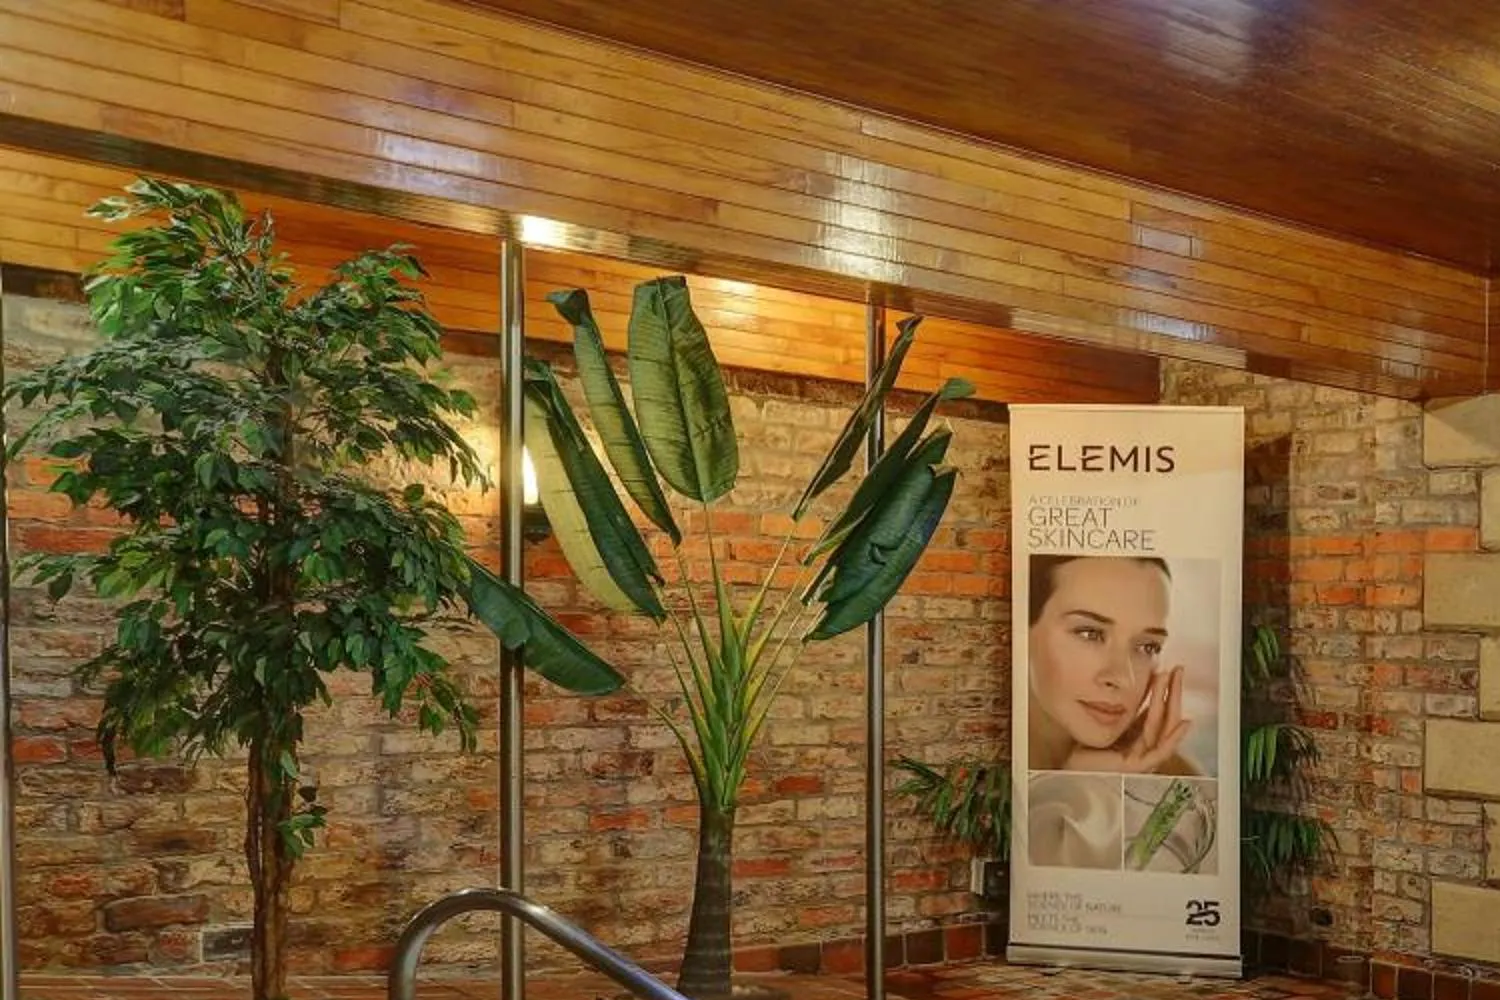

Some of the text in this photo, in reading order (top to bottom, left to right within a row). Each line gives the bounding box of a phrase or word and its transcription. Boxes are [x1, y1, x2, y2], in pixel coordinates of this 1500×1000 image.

[1028, 444, 1176, 473] ELEMIS
[1028, 507, 1112, 528] GREAT
[1028, 528, 1156, 551] SKINCARE
[1185, 899, 1220, 926] 25
